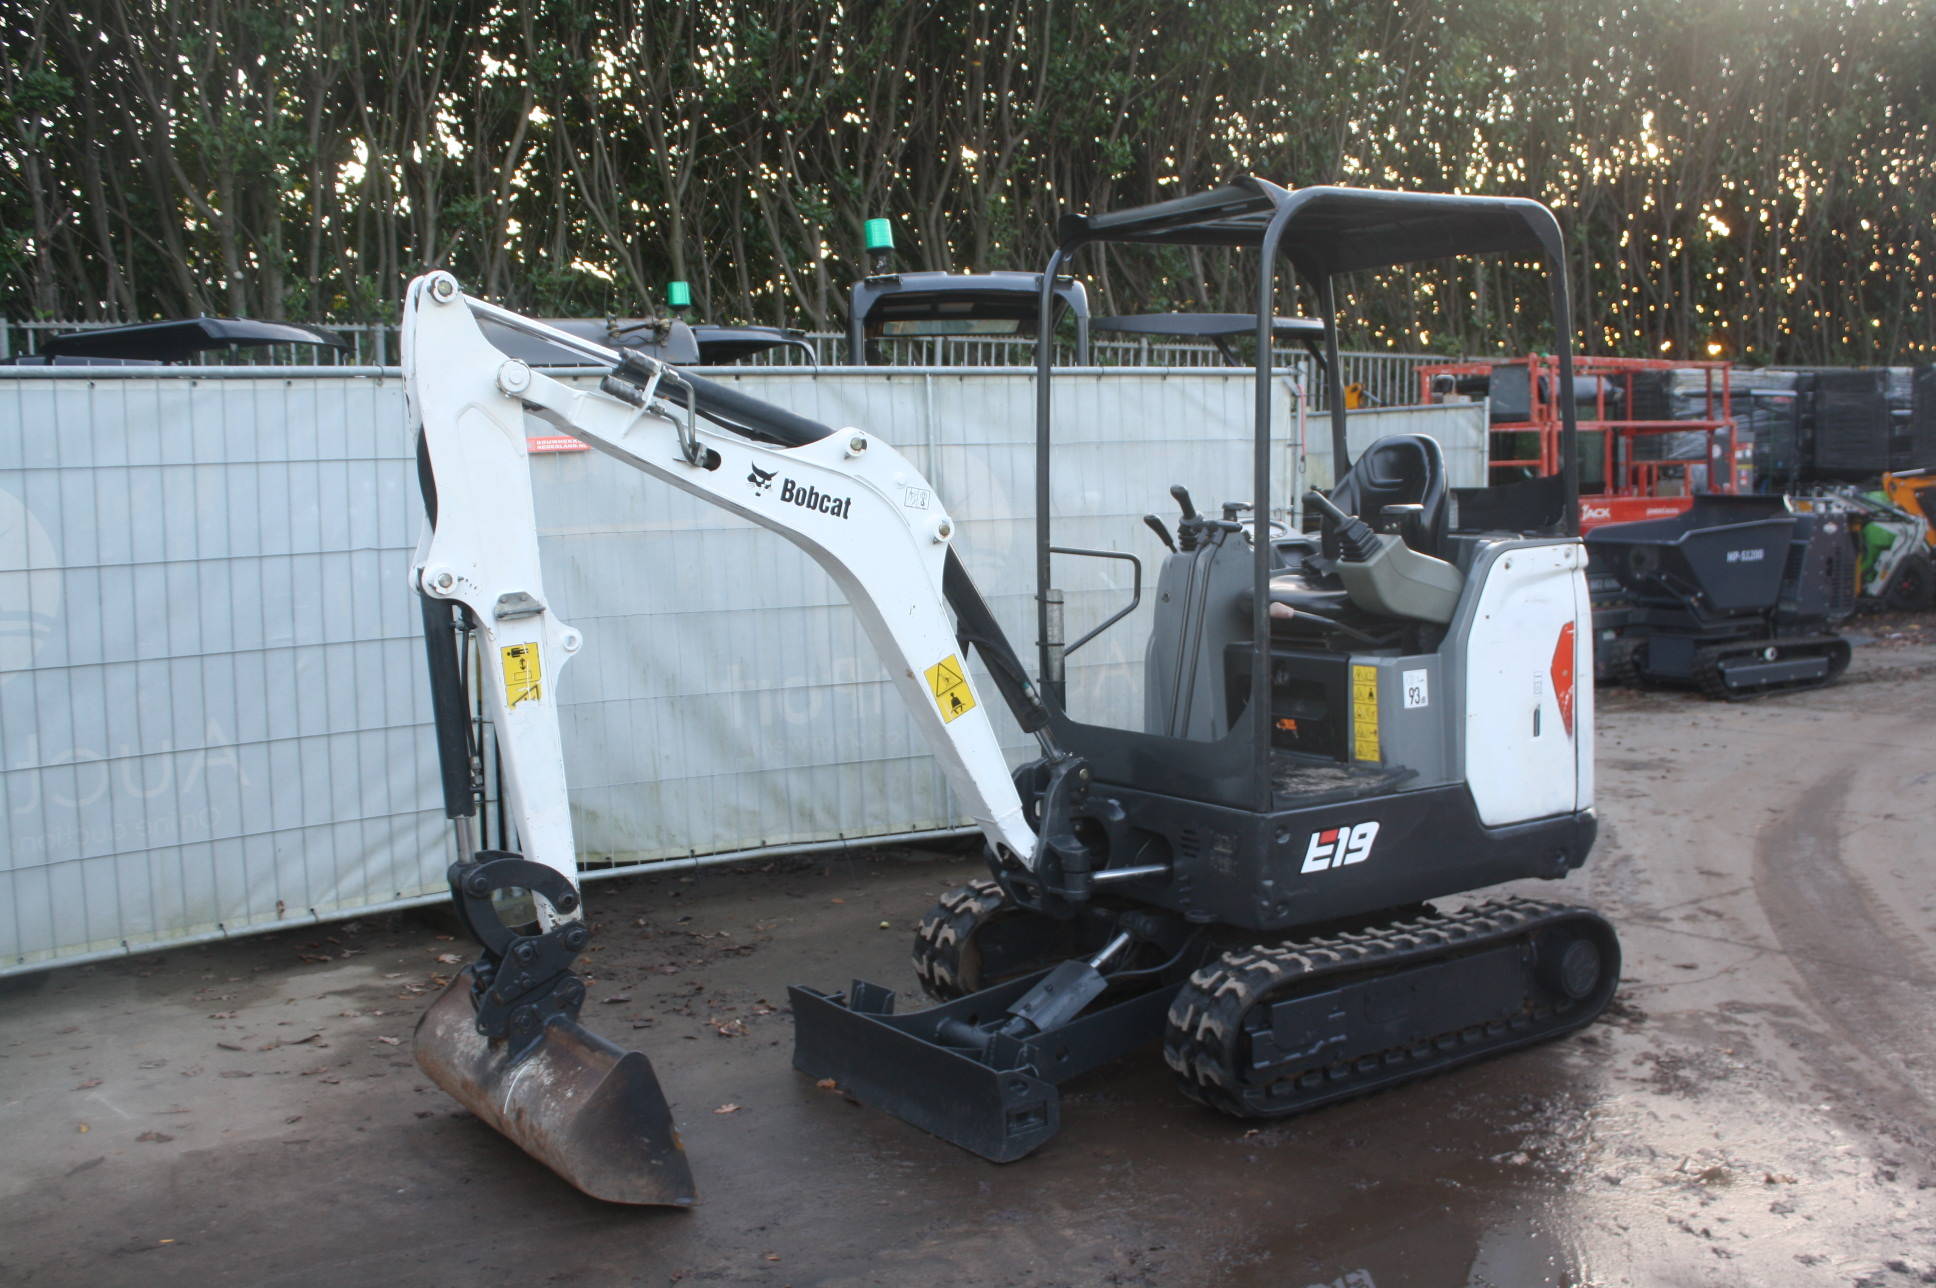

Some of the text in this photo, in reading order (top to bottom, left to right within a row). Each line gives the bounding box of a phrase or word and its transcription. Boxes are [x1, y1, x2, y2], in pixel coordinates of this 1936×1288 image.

[780, 478, 851, 520] Bobcat
[1408, 686, 1420, 705] 93
[1300, 821, 1380, 874] E19
